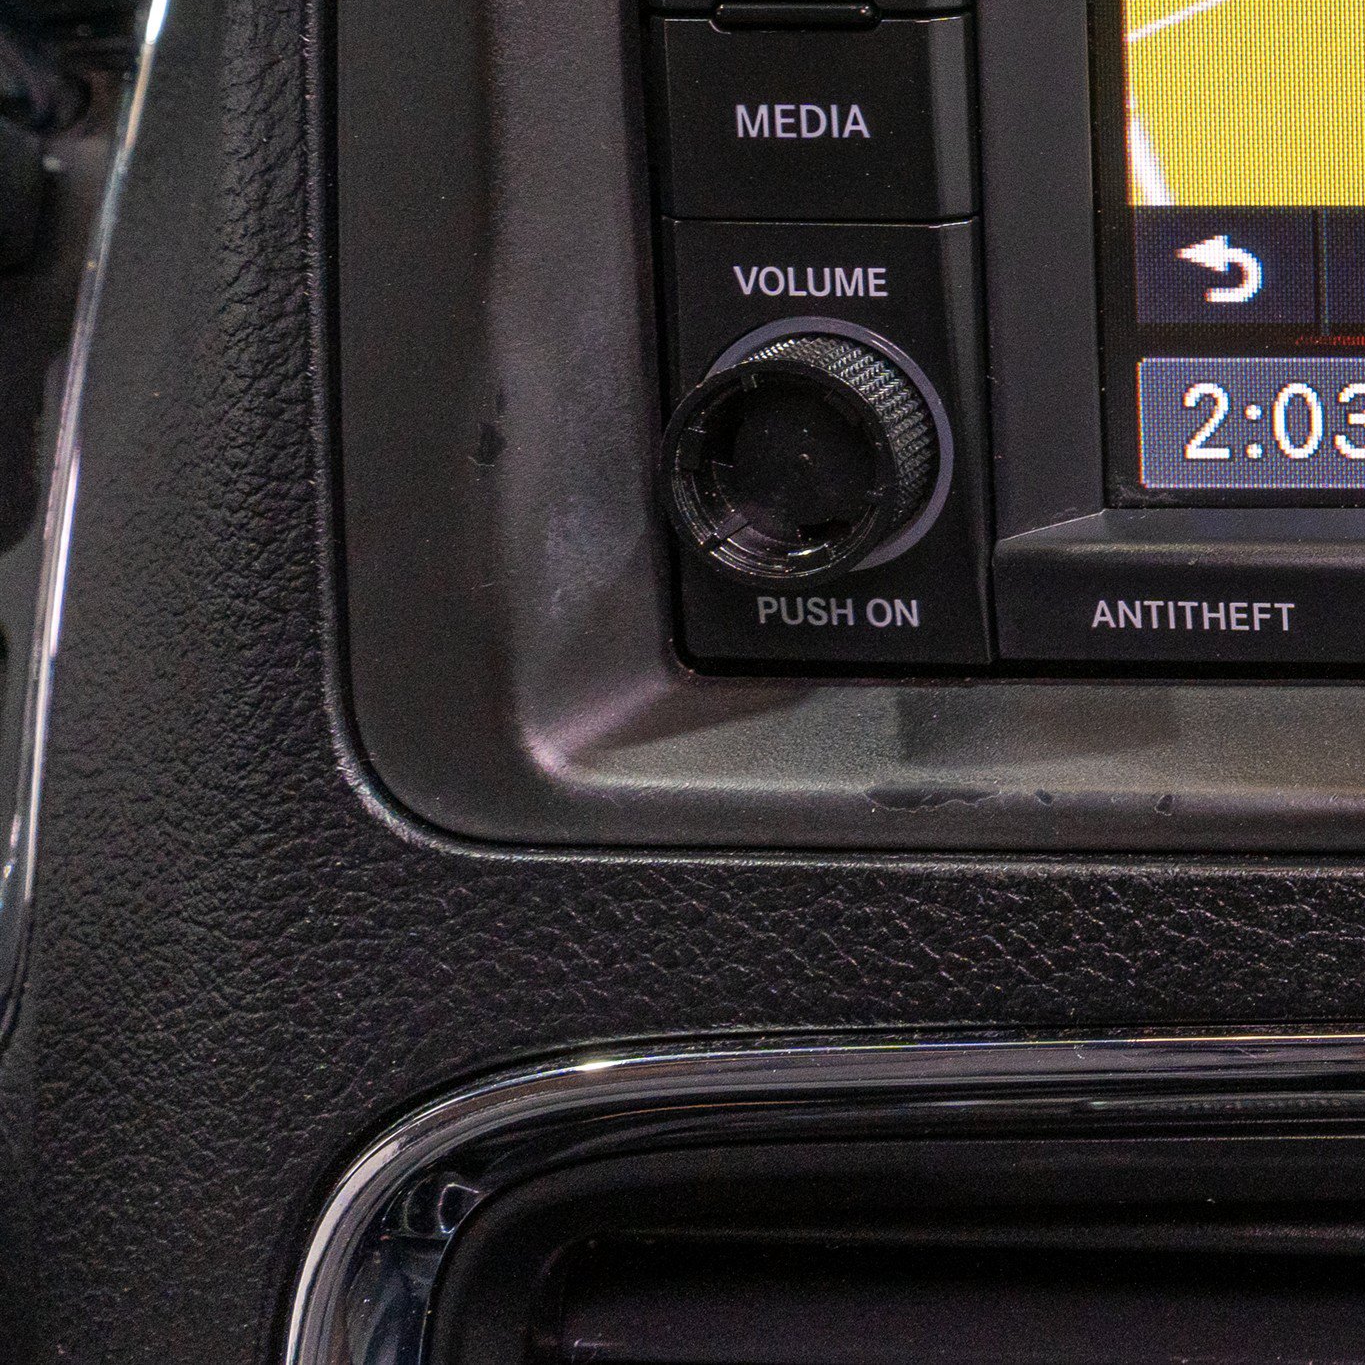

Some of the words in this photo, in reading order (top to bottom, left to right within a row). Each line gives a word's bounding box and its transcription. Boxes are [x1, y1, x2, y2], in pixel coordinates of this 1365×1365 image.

[735, 104, 871, 138] MEDIA
[734, 266, 889, 297] VOLUME
[757, 597, 855, 626] PUSH
[866, 598, 919, 627] ON
[1091, 599, 1295, 631] ANTITHEFT
